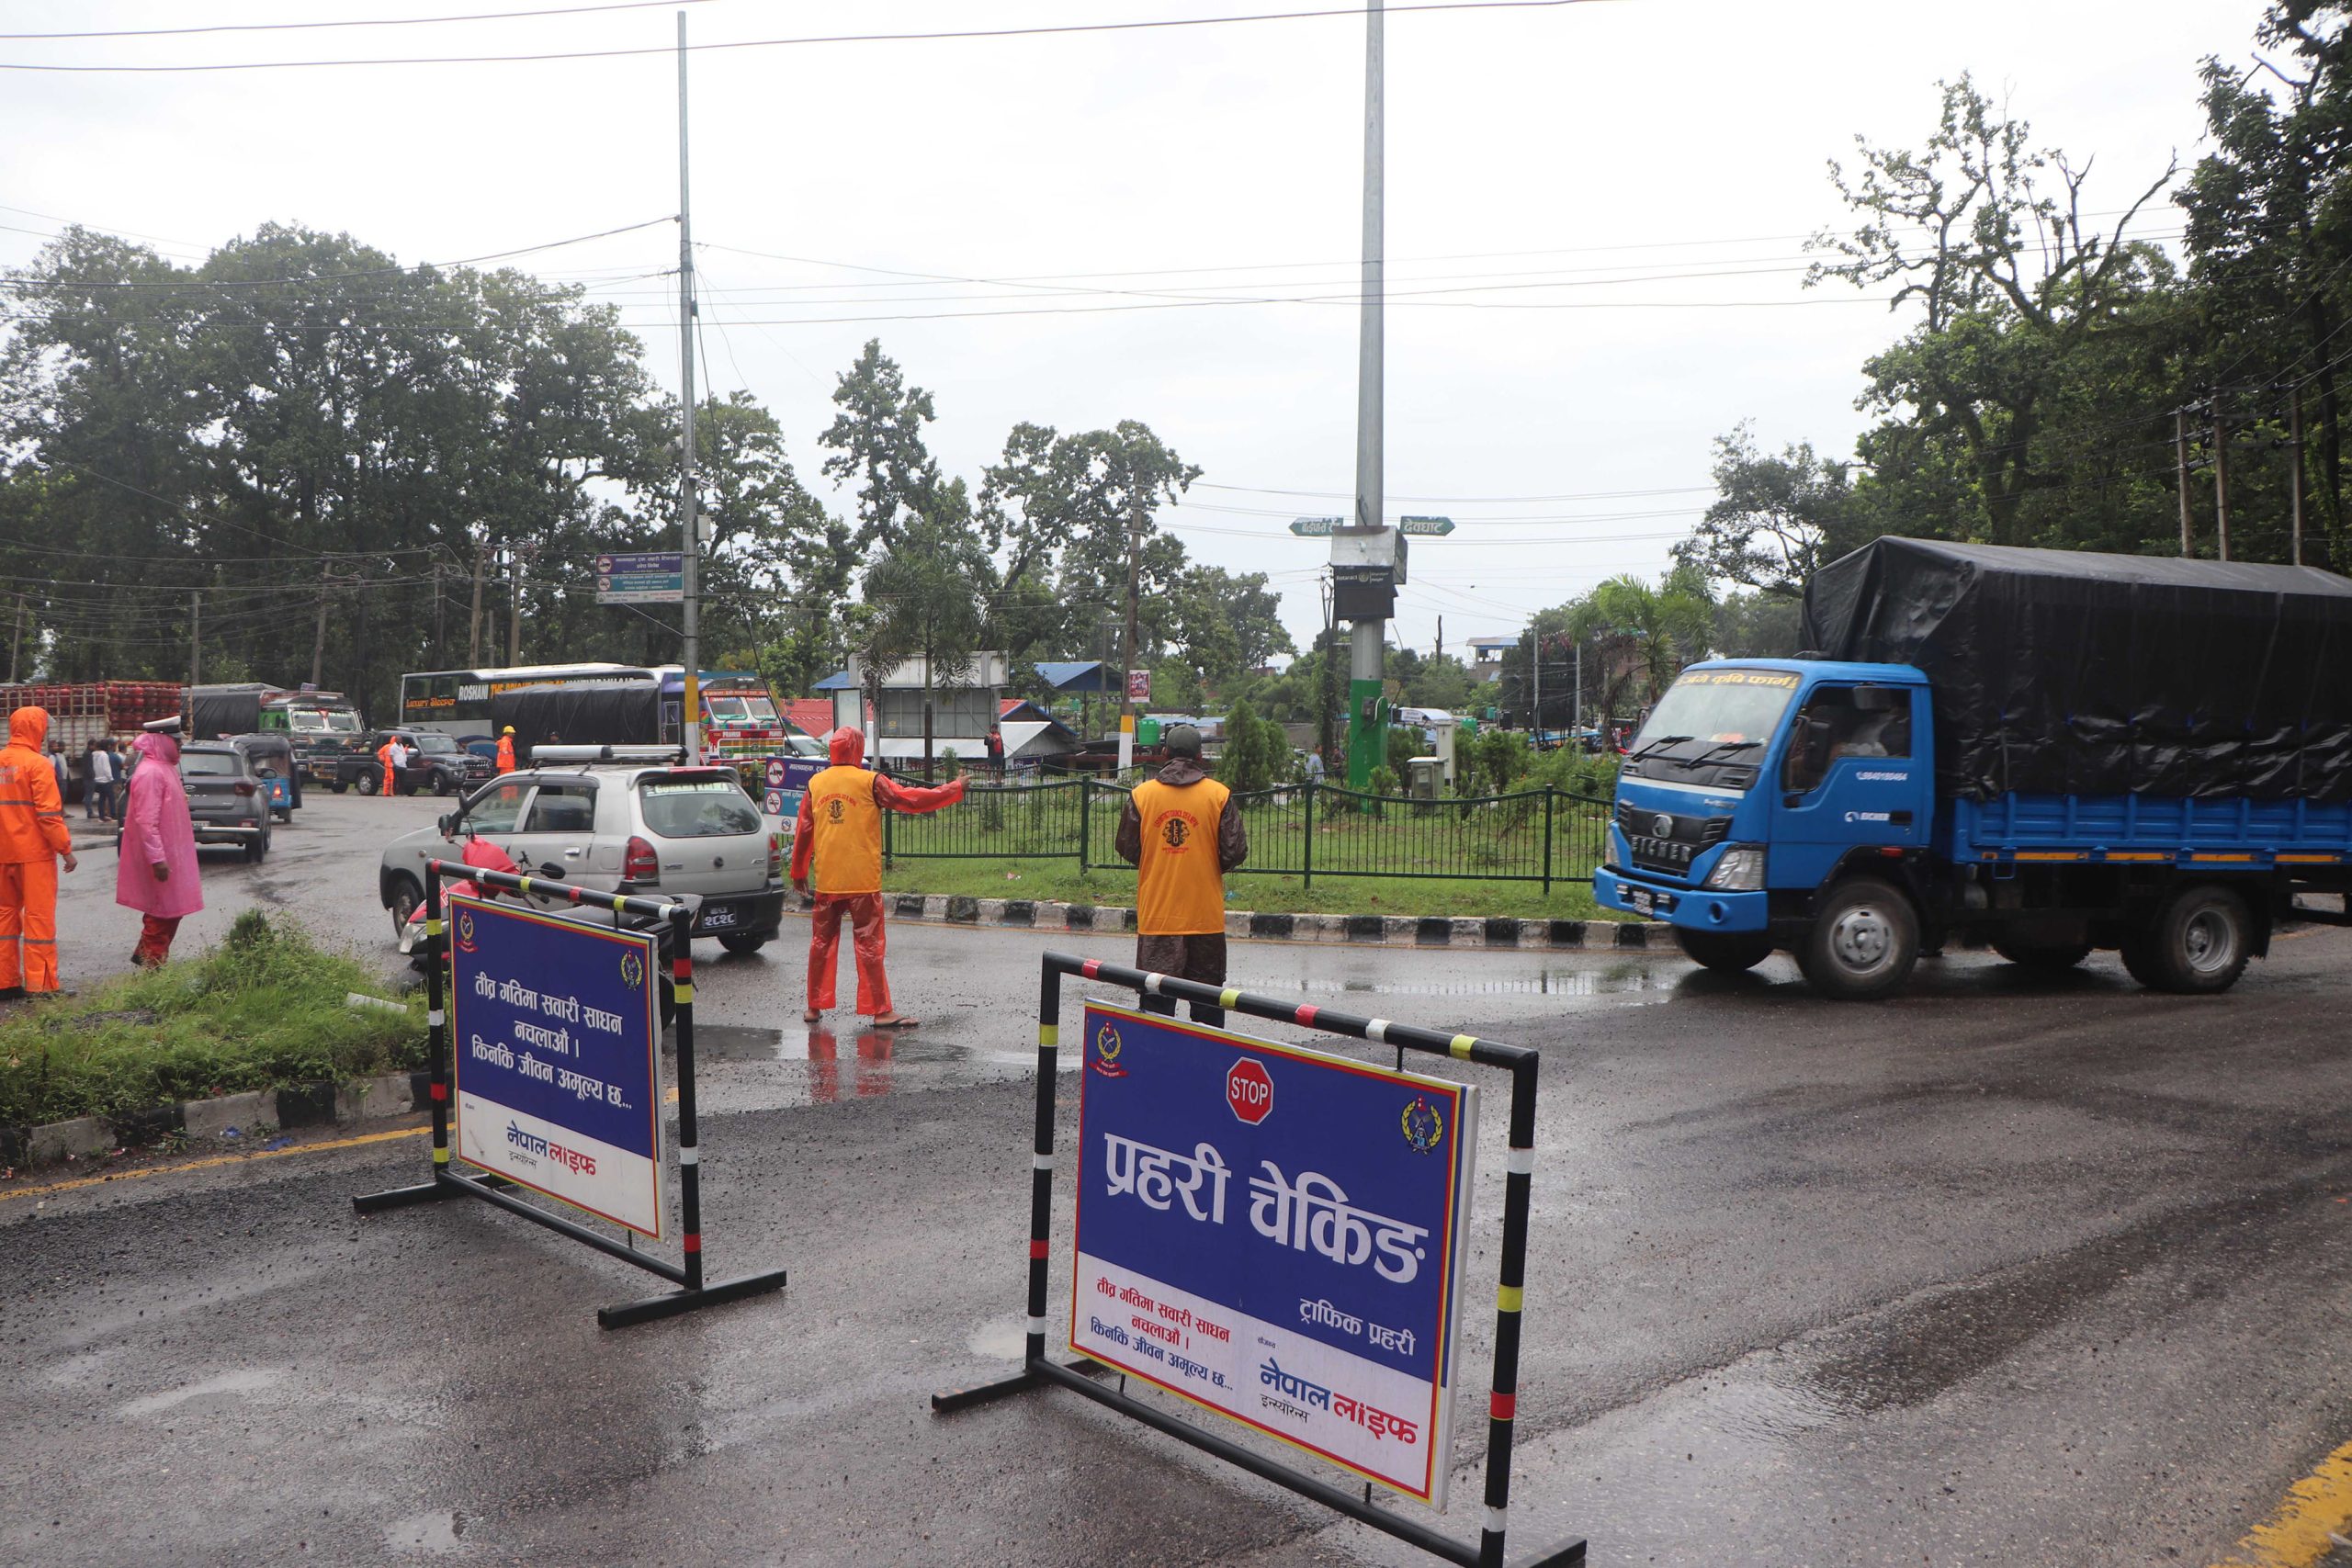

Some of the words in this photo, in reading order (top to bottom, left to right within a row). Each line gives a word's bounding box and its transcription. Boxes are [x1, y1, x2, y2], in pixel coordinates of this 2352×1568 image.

[406, 698, 428, 708] Luxury
[430, 697, 456, 707] Sleeper
[458, 684, 489, 701] ROSHANI
[1631, 837, 1691, 863] EICHER
[499, 978, 538, 1010] गतिमा
[541, 996, 580, 1023] सवारी
[583, 1006, 623, 1035] साधन
[471, 1034, 514, 1069] किनकि
[517, 1052, 554, 1083] जीवन
[558, 1067, 604, 1100] अमूल्य
[1231, 1076, 1269, 1106] STOP
[506, 1119, 548, 1157] नेपाल
[548, 1142, 596, 1176] लाइफ
[1104, 1132, 1231, 1224] प्रहरी
[1249, 1159, 1429, 1284] चेकिङ
[1119, 1287, 1155, 1313] गतिमा
[1158, 1302, 1193, 1328] सवारी
[1195, 1316, 1231, 1343] साधन
[1299, 1297, 1363, 1336] ट्राफिक
[1368, 1322, 1417, 1356] प्रहरी
[1091, 1316, 1129, 1346] किनकि
[1132, 1336, 1165, 1362] जीवन
[1168, 1352, 1209, 1381] अमूल्य
[1260, 1357, 1331, 1411] नेपाल
[1333, 1392, 1419, 1445] लाइफ
